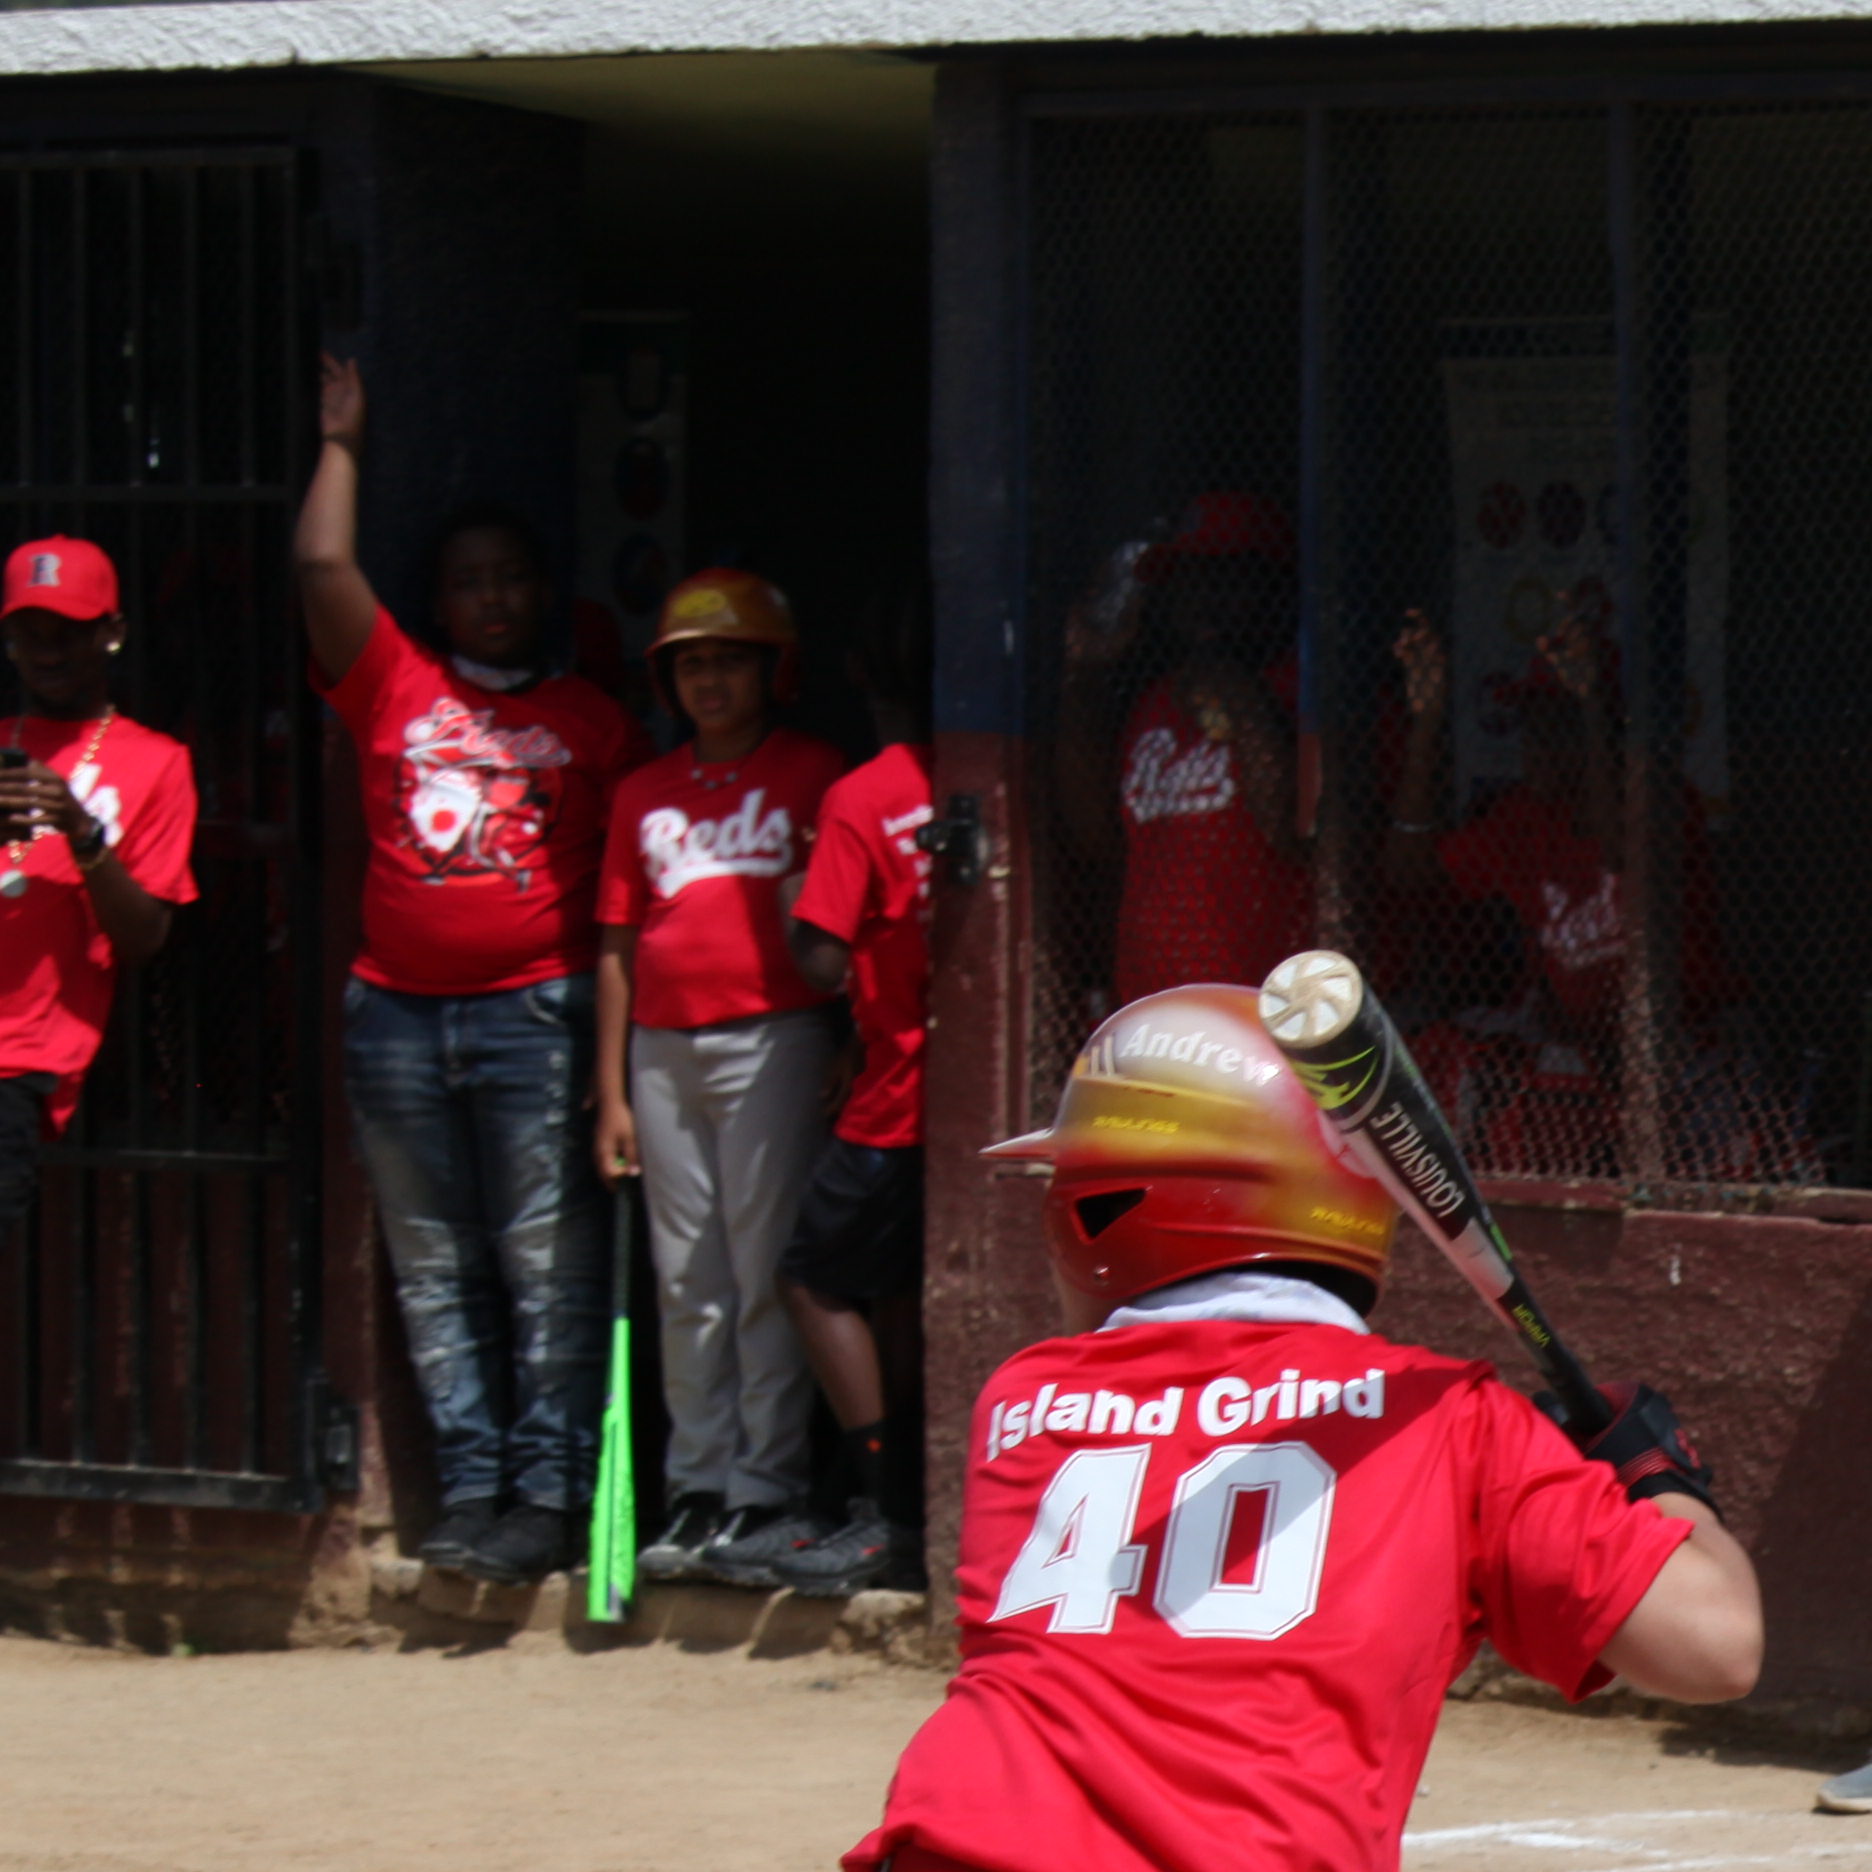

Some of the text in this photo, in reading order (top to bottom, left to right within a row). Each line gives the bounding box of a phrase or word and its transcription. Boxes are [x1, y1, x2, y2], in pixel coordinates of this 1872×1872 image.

[28, 553, 63, 588] R
[640, 788, 793, 890] Reds
[1119, 1023, 1281, 1086] Andrew
[1369, 1101, 1466, 1218] LOUISVILLE
[986, 1368, 1386, 1463] Island Grind
[985, 1440, 1338, 1641] 40
